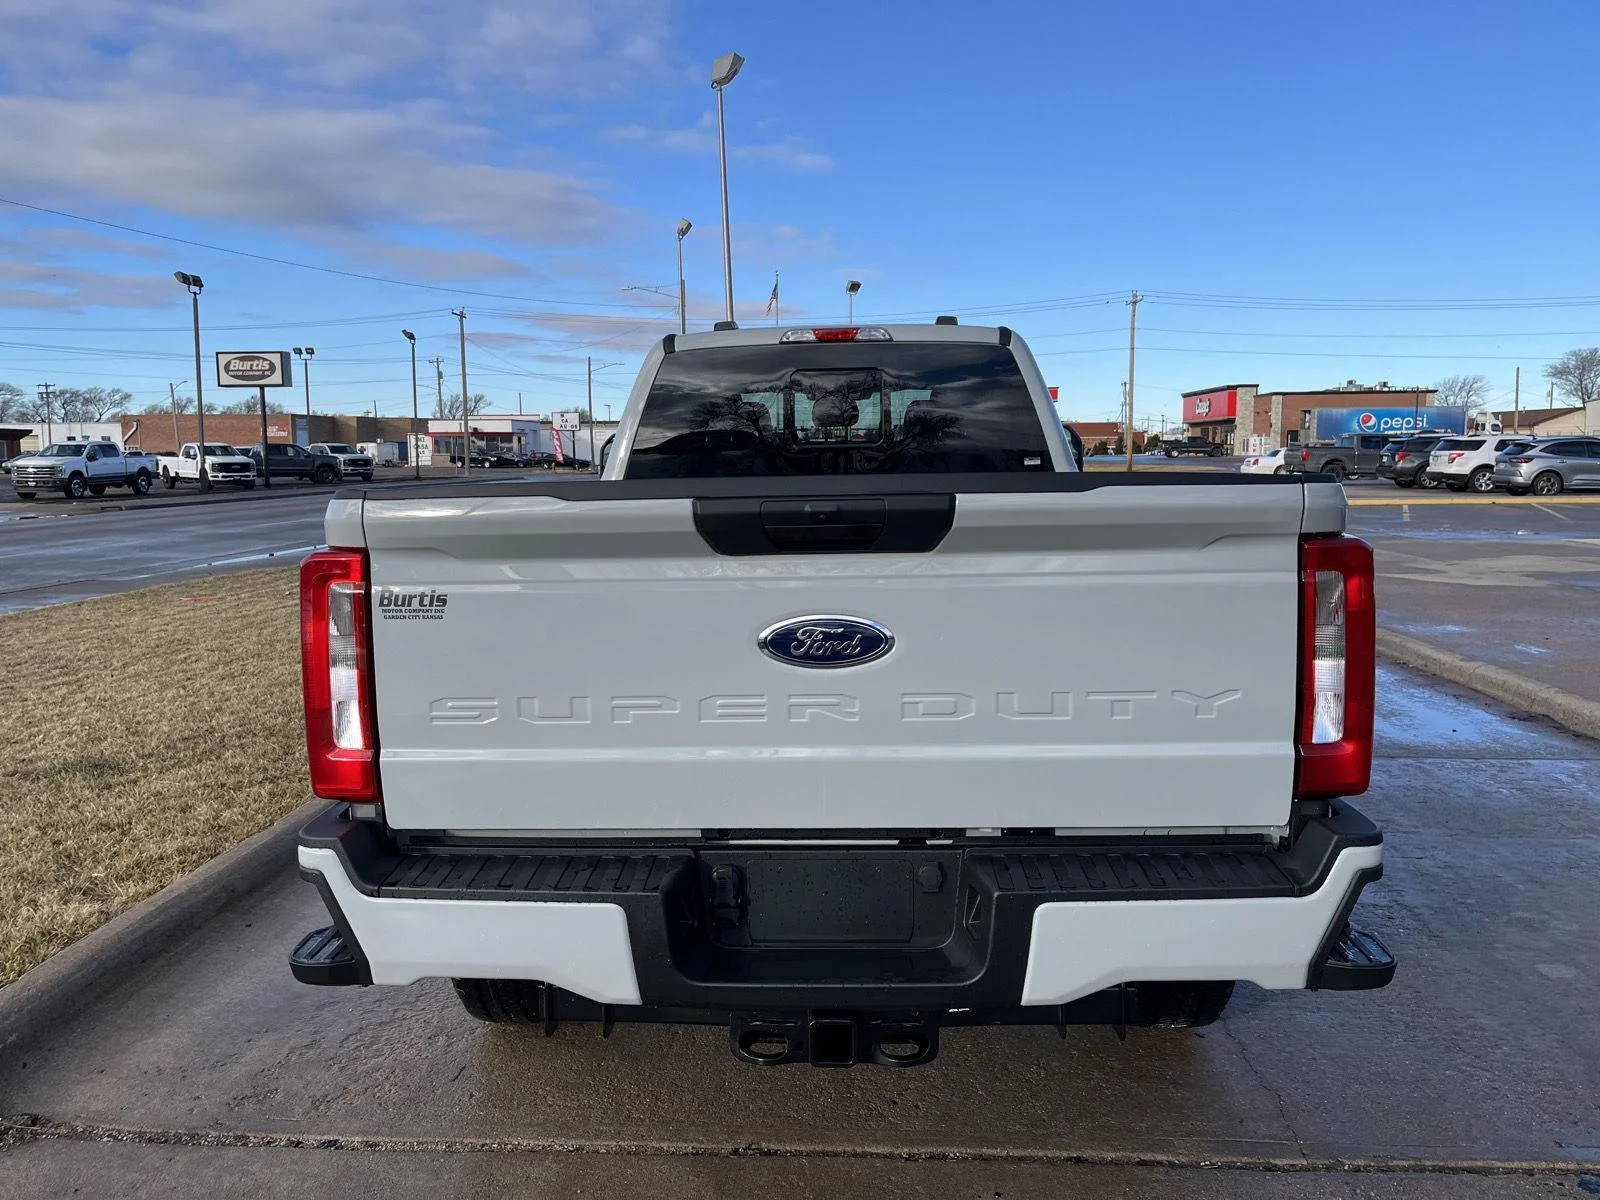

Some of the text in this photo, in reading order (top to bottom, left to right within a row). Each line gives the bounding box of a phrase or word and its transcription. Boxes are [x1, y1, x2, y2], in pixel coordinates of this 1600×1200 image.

[229, 359, 270, 370] Burtis
[1380, 414, 1428, 431] pepsi
[378, 590, 448, 608] Burtis
[790, 626, 862, 656] Ford
[429, 689, 1242, 725] SUPER DUTY
